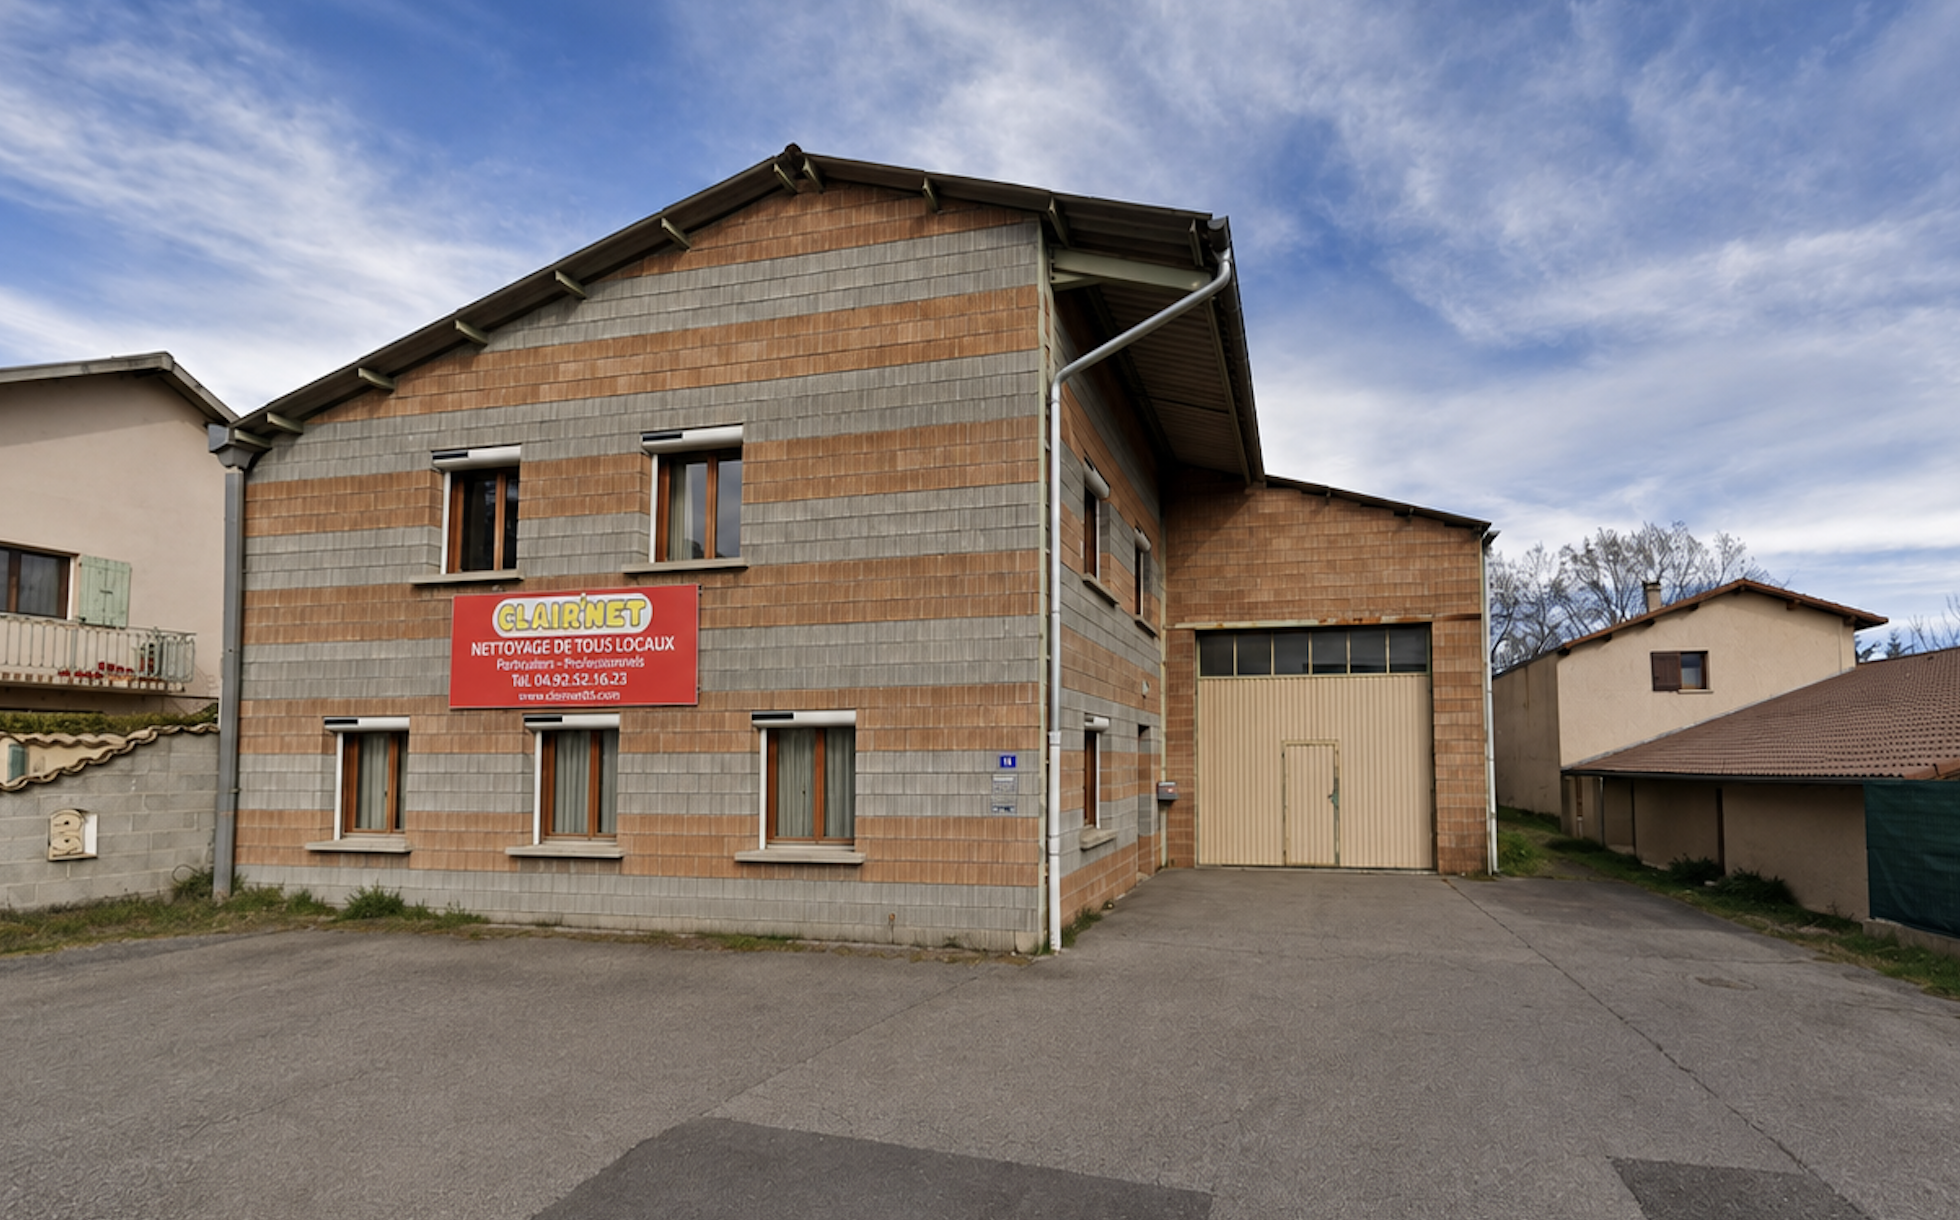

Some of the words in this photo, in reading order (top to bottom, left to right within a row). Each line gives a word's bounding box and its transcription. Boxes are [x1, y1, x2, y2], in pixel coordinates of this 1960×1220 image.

[497, 593, 647, 631] CLAIR'NET
[470, 639, 551, 657] NETTOYAGE
[553, 639, 572, 654] DE
[574, 637, 613, 653] TOUS
[615, 635, 675, 652] LOCAUX
